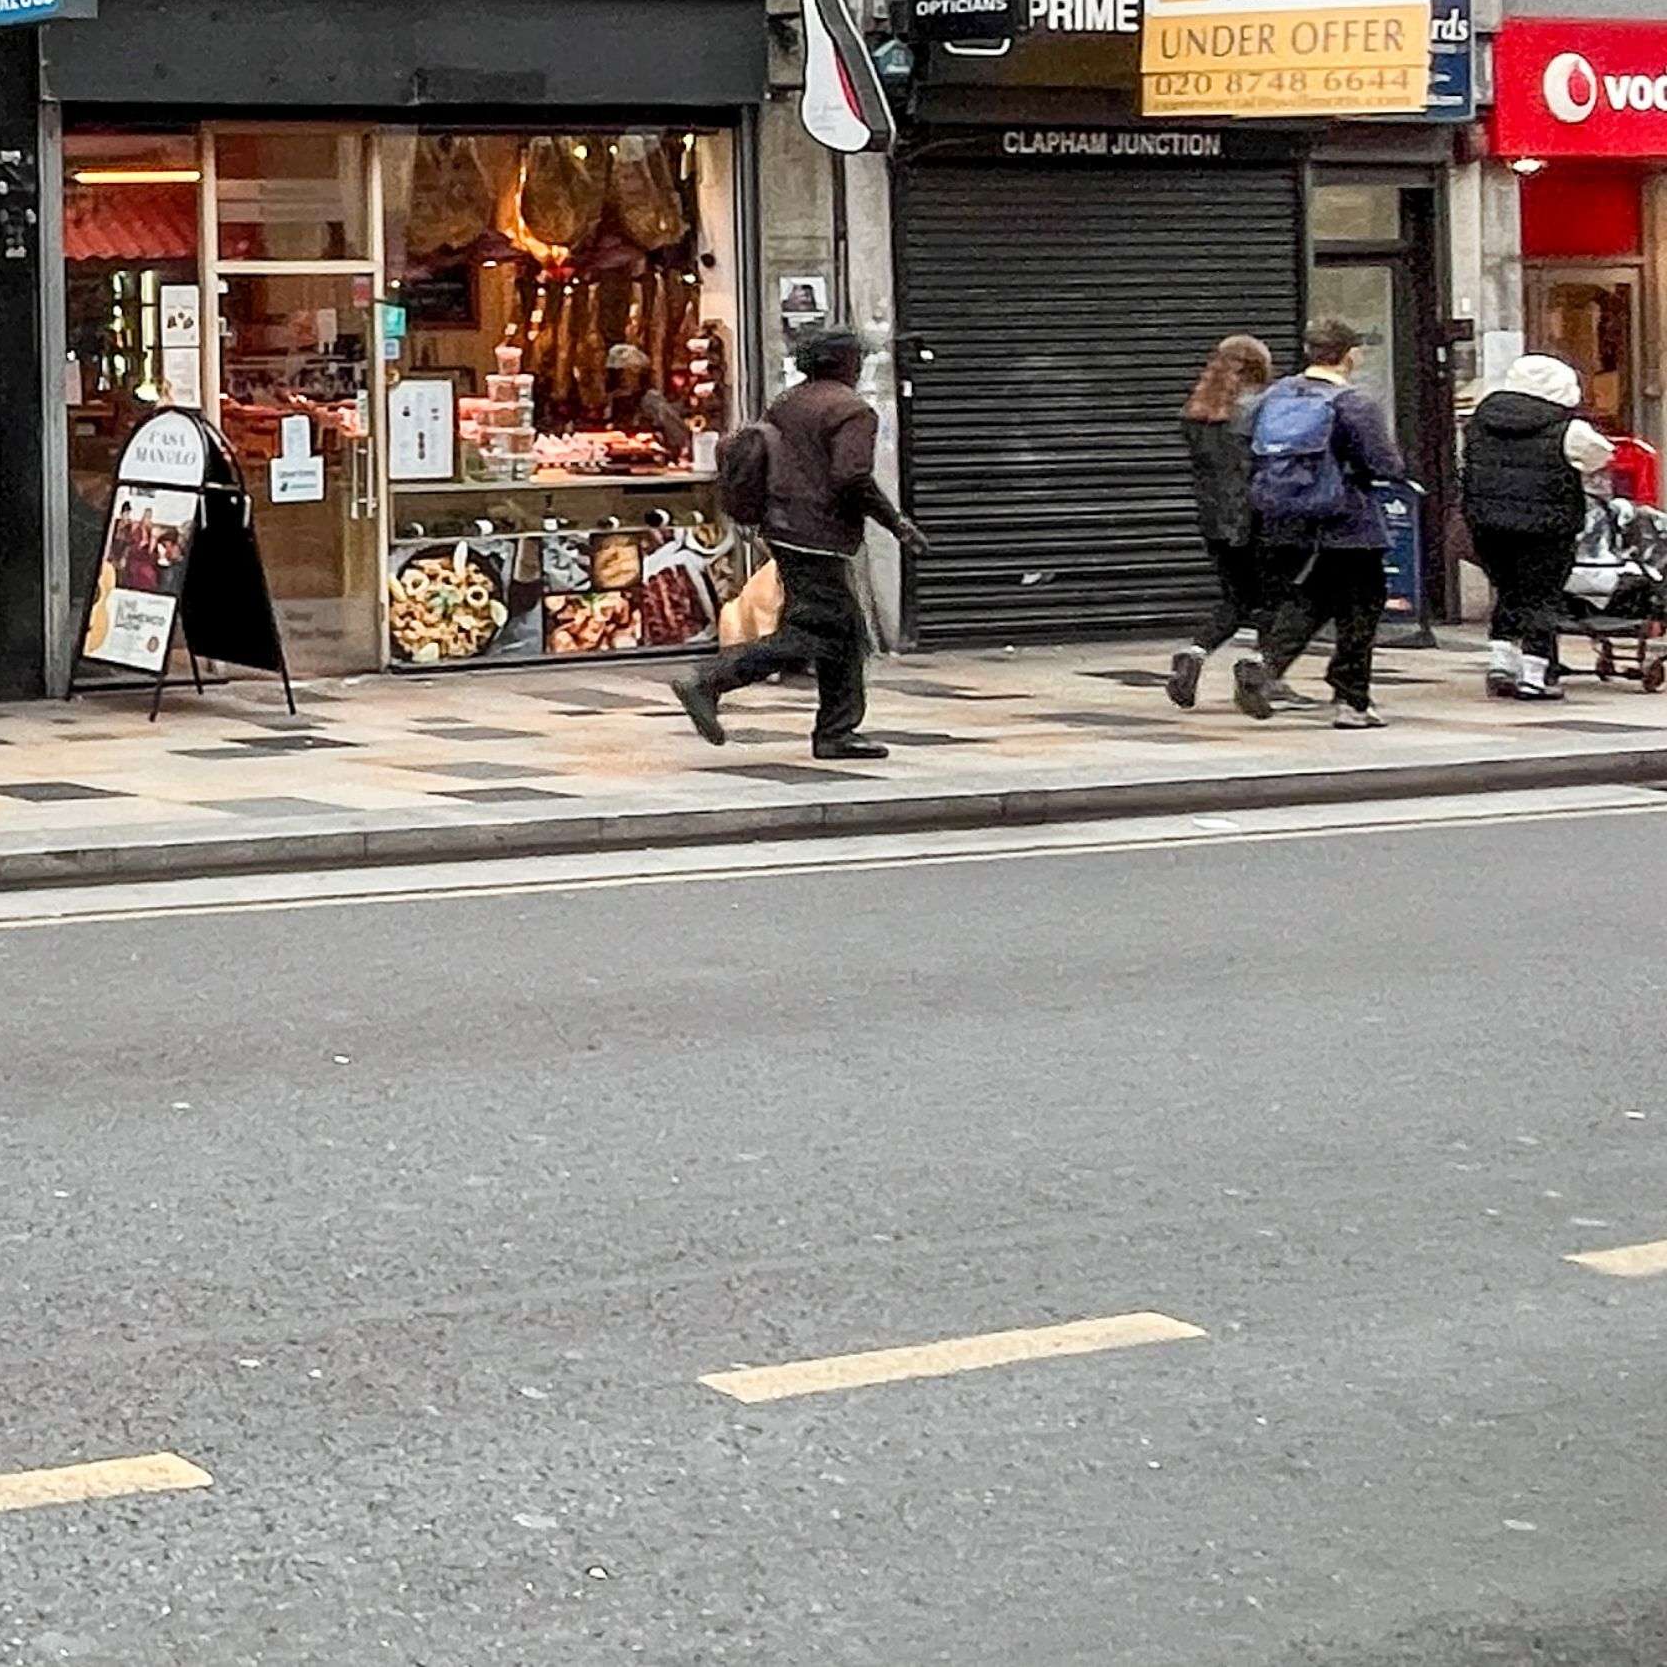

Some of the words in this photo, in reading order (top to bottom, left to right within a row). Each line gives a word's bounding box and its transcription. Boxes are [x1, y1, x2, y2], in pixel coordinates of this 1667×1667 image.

[1431, 8, 1468, 40] rds
[1161, 23, 1276, 60] UNDER
[1291, 19, 1404, 55] OFFER
[1156, 75, 1212, 96] 020
[1226, 71, 1307, 94] 8748
[1322, 69, 1408, 91] 6644
[1003, 132, 1107, 154] CLAPHAM
[1111, 134, 1221, 155] JUNCTION
